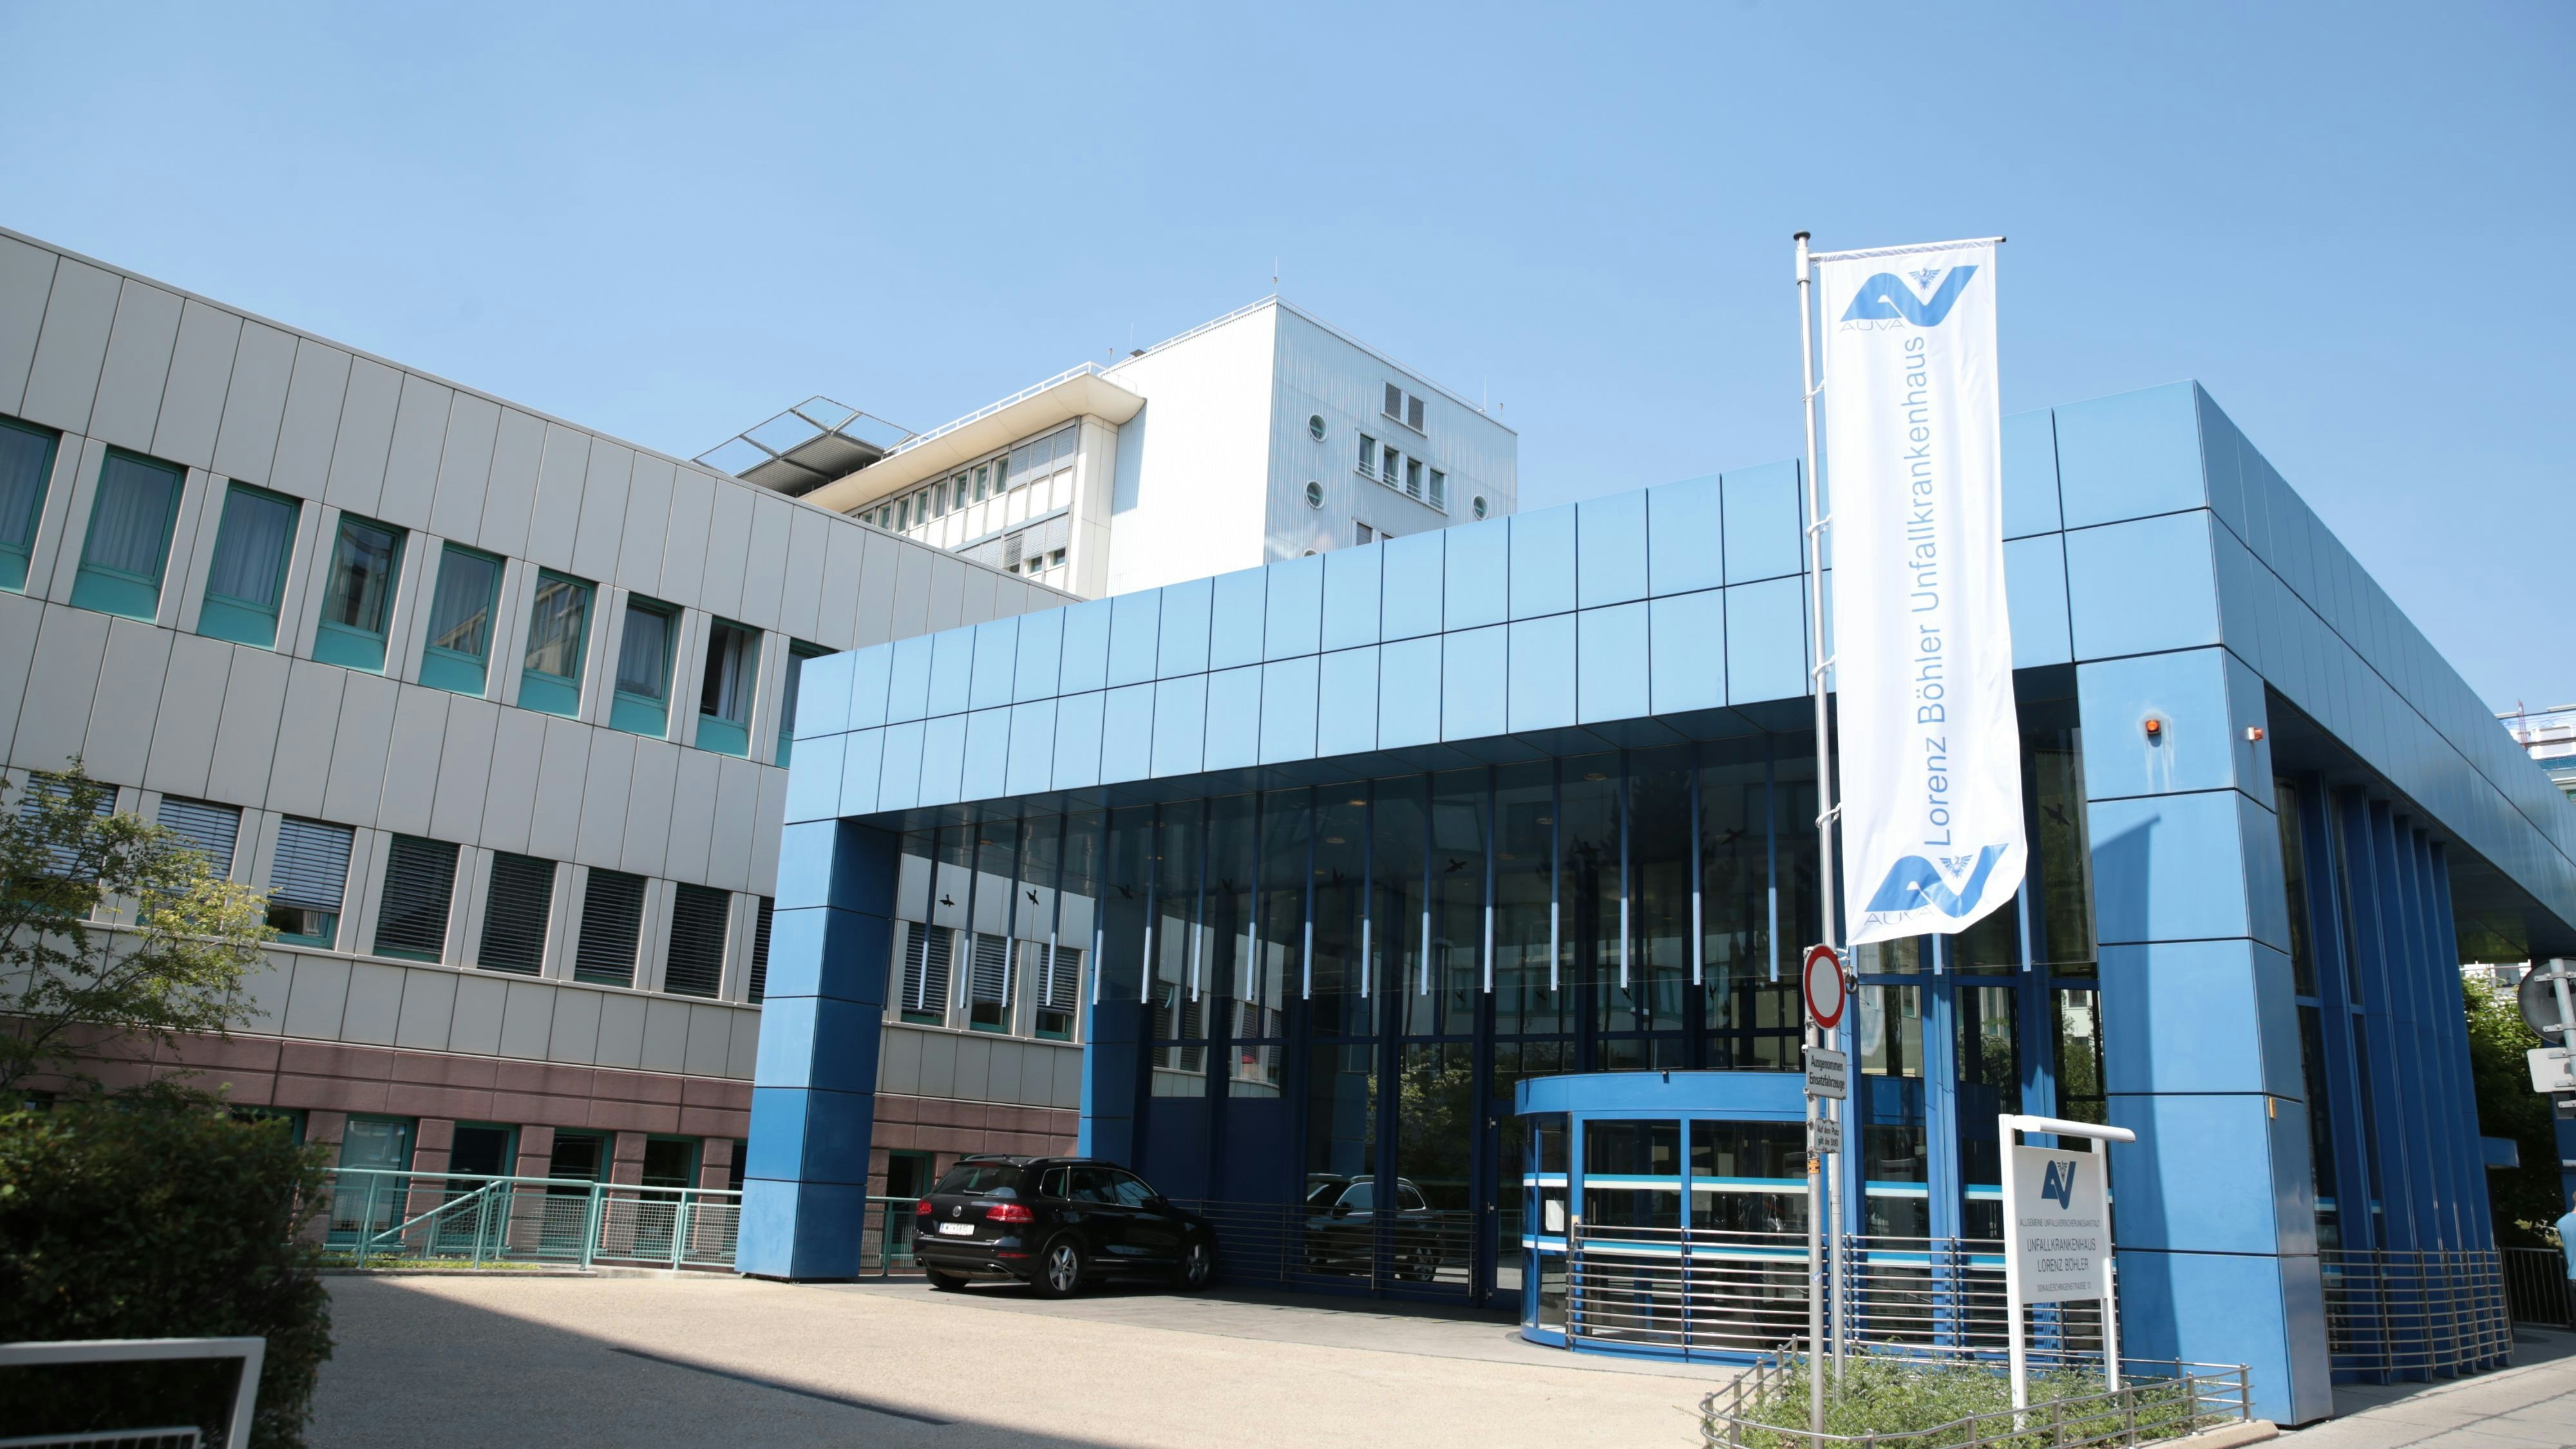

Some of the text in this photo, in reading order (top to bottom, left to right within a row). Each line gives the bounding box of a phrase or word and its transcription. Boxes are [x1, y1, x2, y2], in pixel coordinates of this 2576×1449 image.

[1839, 319, 1906, 333] AUVA
[1900, 336, 1951, 846] Lorenz Böhler Unfallkrankenhaus
[1864, 907, 1935, 925] AUVA
[1811, 1054, 1843, 1072] Ausgenommen
[1809, 1072, 1845, 1092] Einsatzfahrzeuge
[2020, 1218, 2043, 1227] ALLGEMEINE
[2027, 1238, 2096, 1252] UNFALLKRANKENHAUS
[2037, 1257, 2089, 1273] LORENZ BÖHLER
